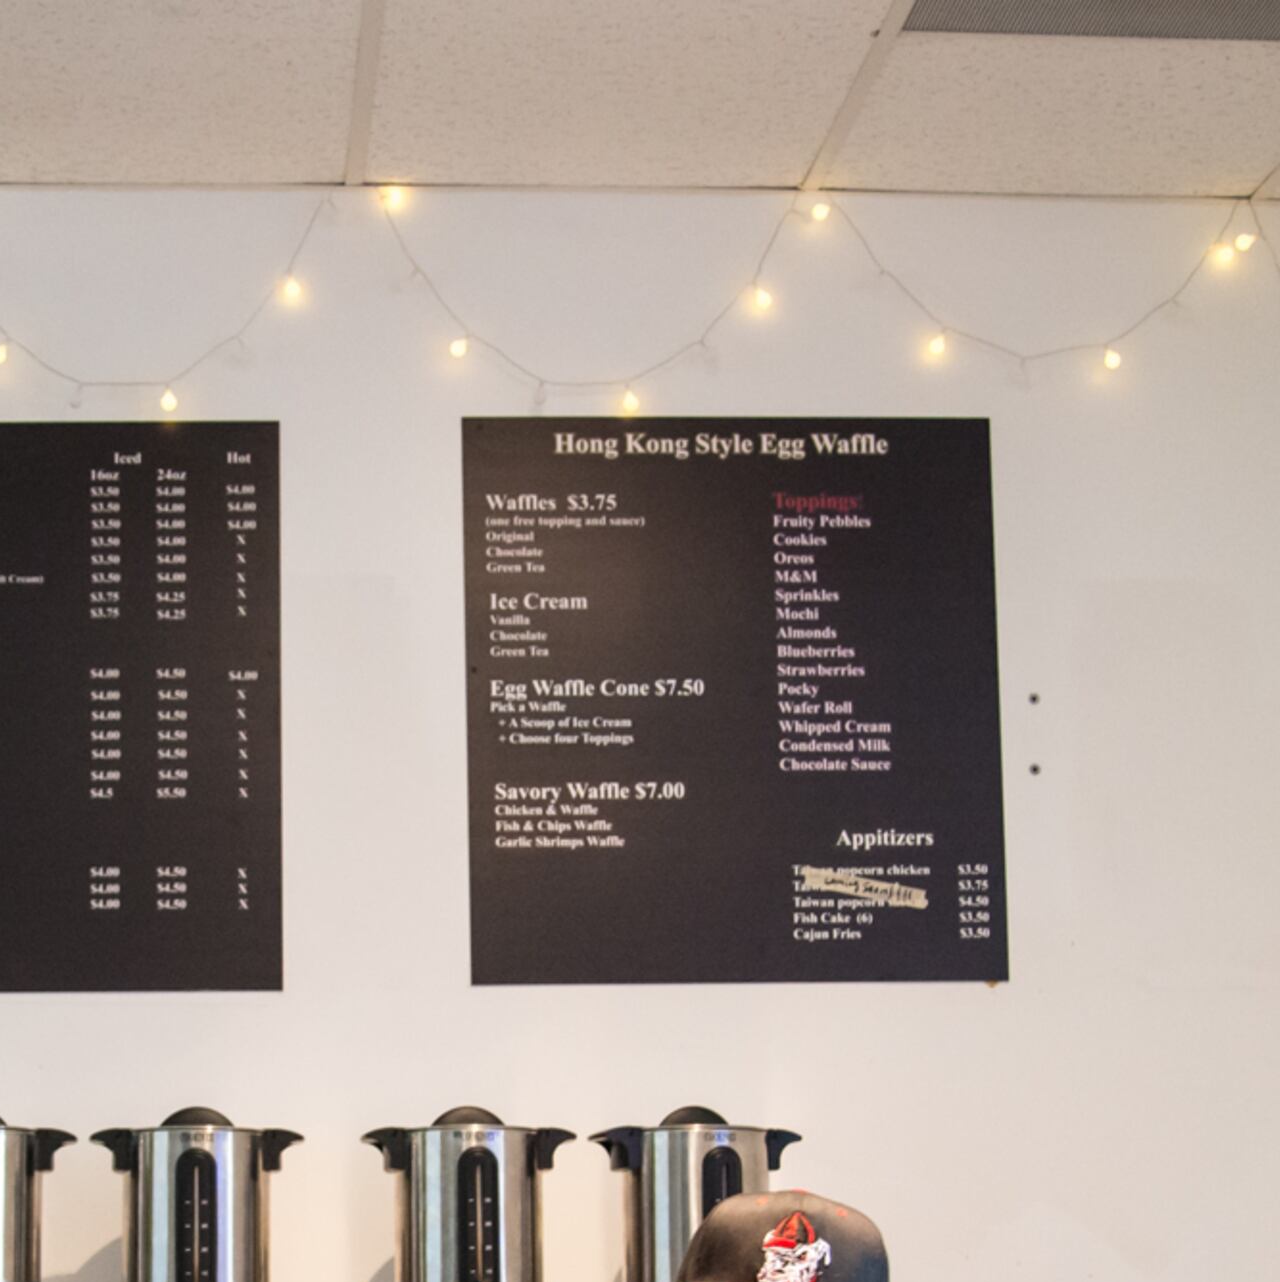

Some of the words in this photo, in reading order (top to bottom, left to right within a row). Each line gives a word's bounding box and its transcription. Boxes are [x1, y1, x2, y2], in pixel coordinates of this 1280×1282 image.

[554, 432, 619, 459] Hong
[625, 432, 689, 459] Kong
[695, 433, 753, 459] Style
[760, 433, 805, 459] Egg
[811, 433, 888, 454] Waffle
[114, 452, 142, 464] Iced
[227, 452, 251, 464] Hot
[91, 469, 119, 481] 16oz
[157, 468, 186, 481] 24oz
[486, 494, 556, 511] Waffles
[567, 494, 617, 511] $3.75
[513, 515, 535, 526] free
[538, 515, 582, 528] topping
[585, 515, 606, 526] and
[773, 514, 815, 530] Fruity
[820, 515, 871, 528] Pebbles
[485, 531, 534, 544] Original
[773, 533, 827, 546] Cookies
[773, 551, 814, 565] Oreos
[486, 562, 522, 573] Green
[526, 562, 545, 572] Tea
[775, 570, 817, 583] M&M
[490, 593, 518, 610] Ice
[523, 593, 588, 610] Cream
[775, 589, 839, 605] Sprinkles
[776, 607, 819, 620] Mochi
[776, 626, 837, 639] Almonds
[777, 645, 855, 658] Blueberries
[777, 664, 865, 676] Strawberries
[490, 680, 527, 701] Egg
[532, 679, 595, 696] Waffle
[600, 679, 649, 696] Cone
[655, 679, 704, 696] $7.50
[778, 682, 819, 698] Pocky
[778, 701, 821, 714] Wafer
[824, 701, 852, 714] Roll
[779, 720, 841, 736] Whipped
[845, 720, 891, 733] Cream
[779, 739, 854, 752] Condensed
[858, 739, 890, 752] Milk
[779, 758, 848, 771] Chocolate
[851, 758, 891, 771] Sauce
[495, 783, 561, 803] Savory
[567, 782, 630, 799] Waffle
[635, 782, 685, 800] $7.00
[494, 805, 543, 816] Chicken
[560, 804, 598, 815] Waffle
[496, 820, 520, 832] Fish
[537, 820, 572, 834] Chips
[574, 820, 612, 831] Waffle
[495, 836, 532, 848] Garlic
[535, 836, 584, 850] Shrimps
[586, 835, 625, 847] Waffle
[837, 829, 934, 849] Appitizers
[886, 864, 930, 875] chicken
[793, 912, 818, 924] Fish
[820, 912, 851, 923] Cake
[793, 928, 829, 942] Cajun
[832, 928, 862, 939] Fries
